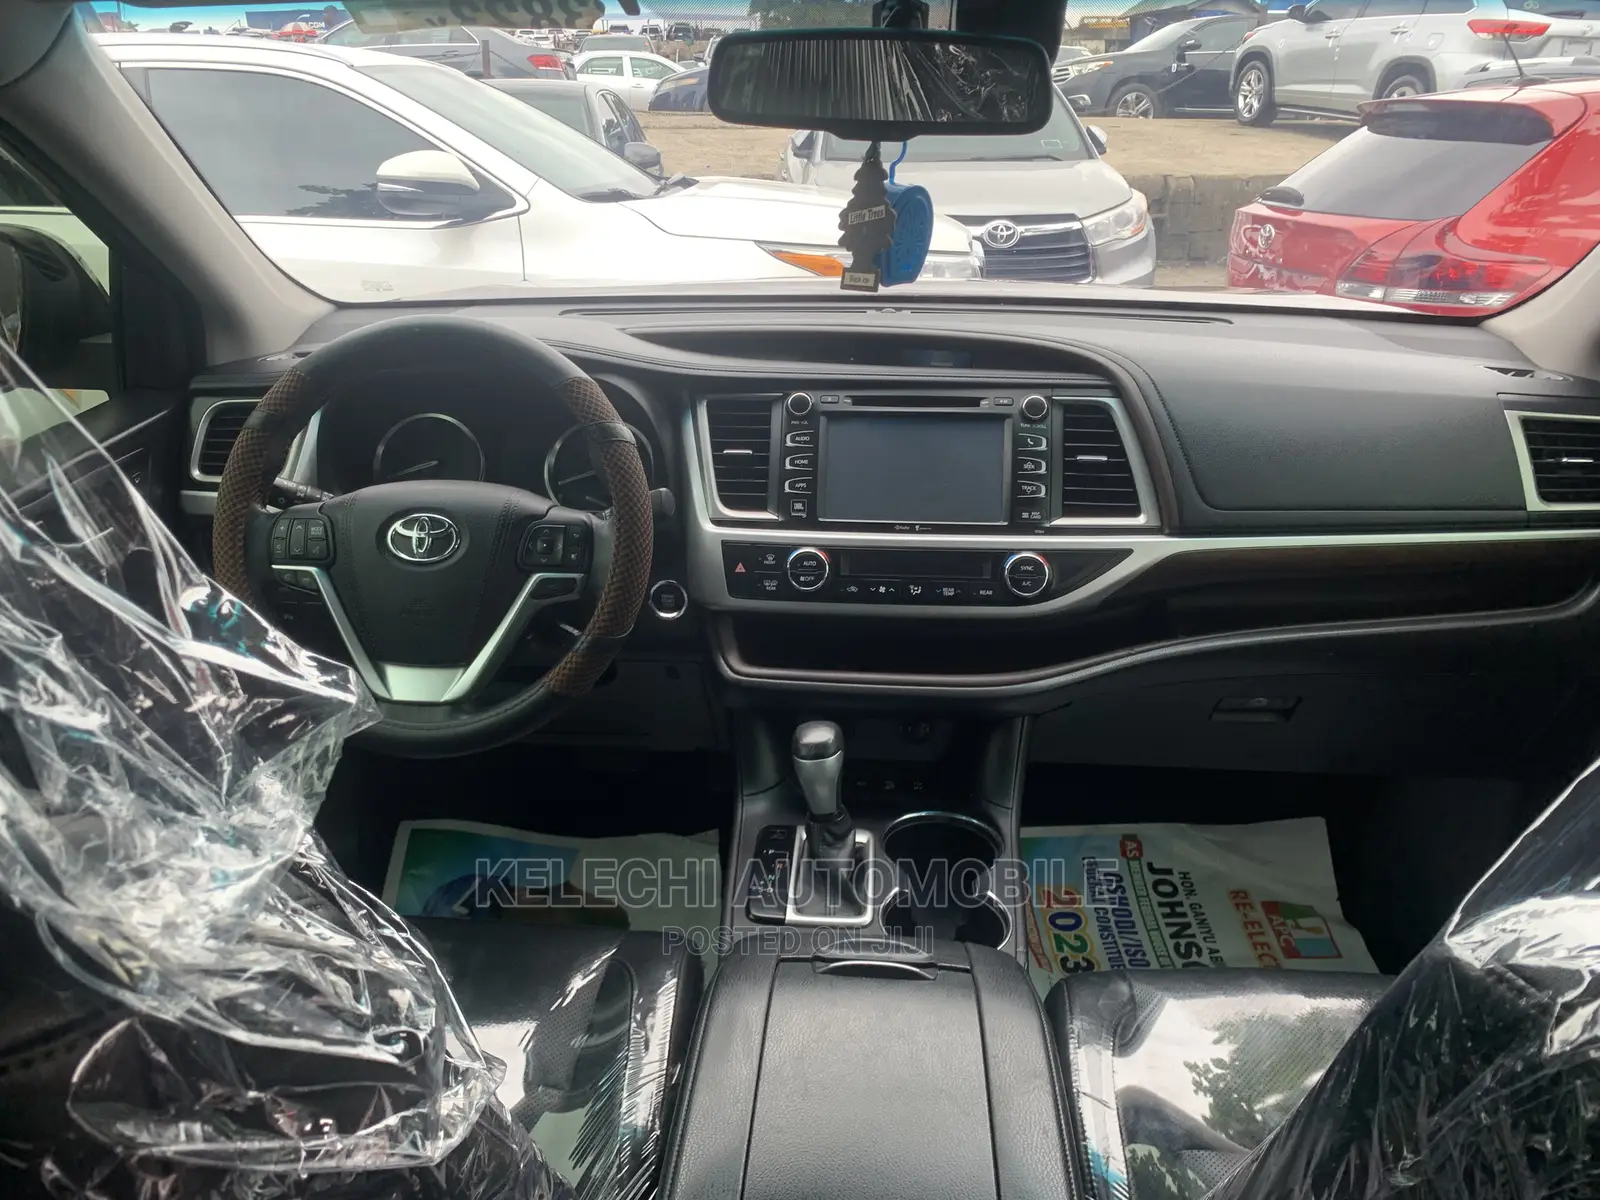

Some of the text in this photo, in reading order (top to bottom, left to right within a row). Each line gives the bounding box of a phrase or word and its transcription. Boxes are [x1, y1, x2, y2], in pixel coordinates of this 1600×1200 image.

[308, 21, 326, 29] CGM
[1124, 839, 1140, 859] AS
[1178, 870, 1200, 900] HON.
[1189, 902, 1217, 944] GANIYU
[1043, 889, 1095, 974] 2023
[1268, 914, 1295, 952] APC
